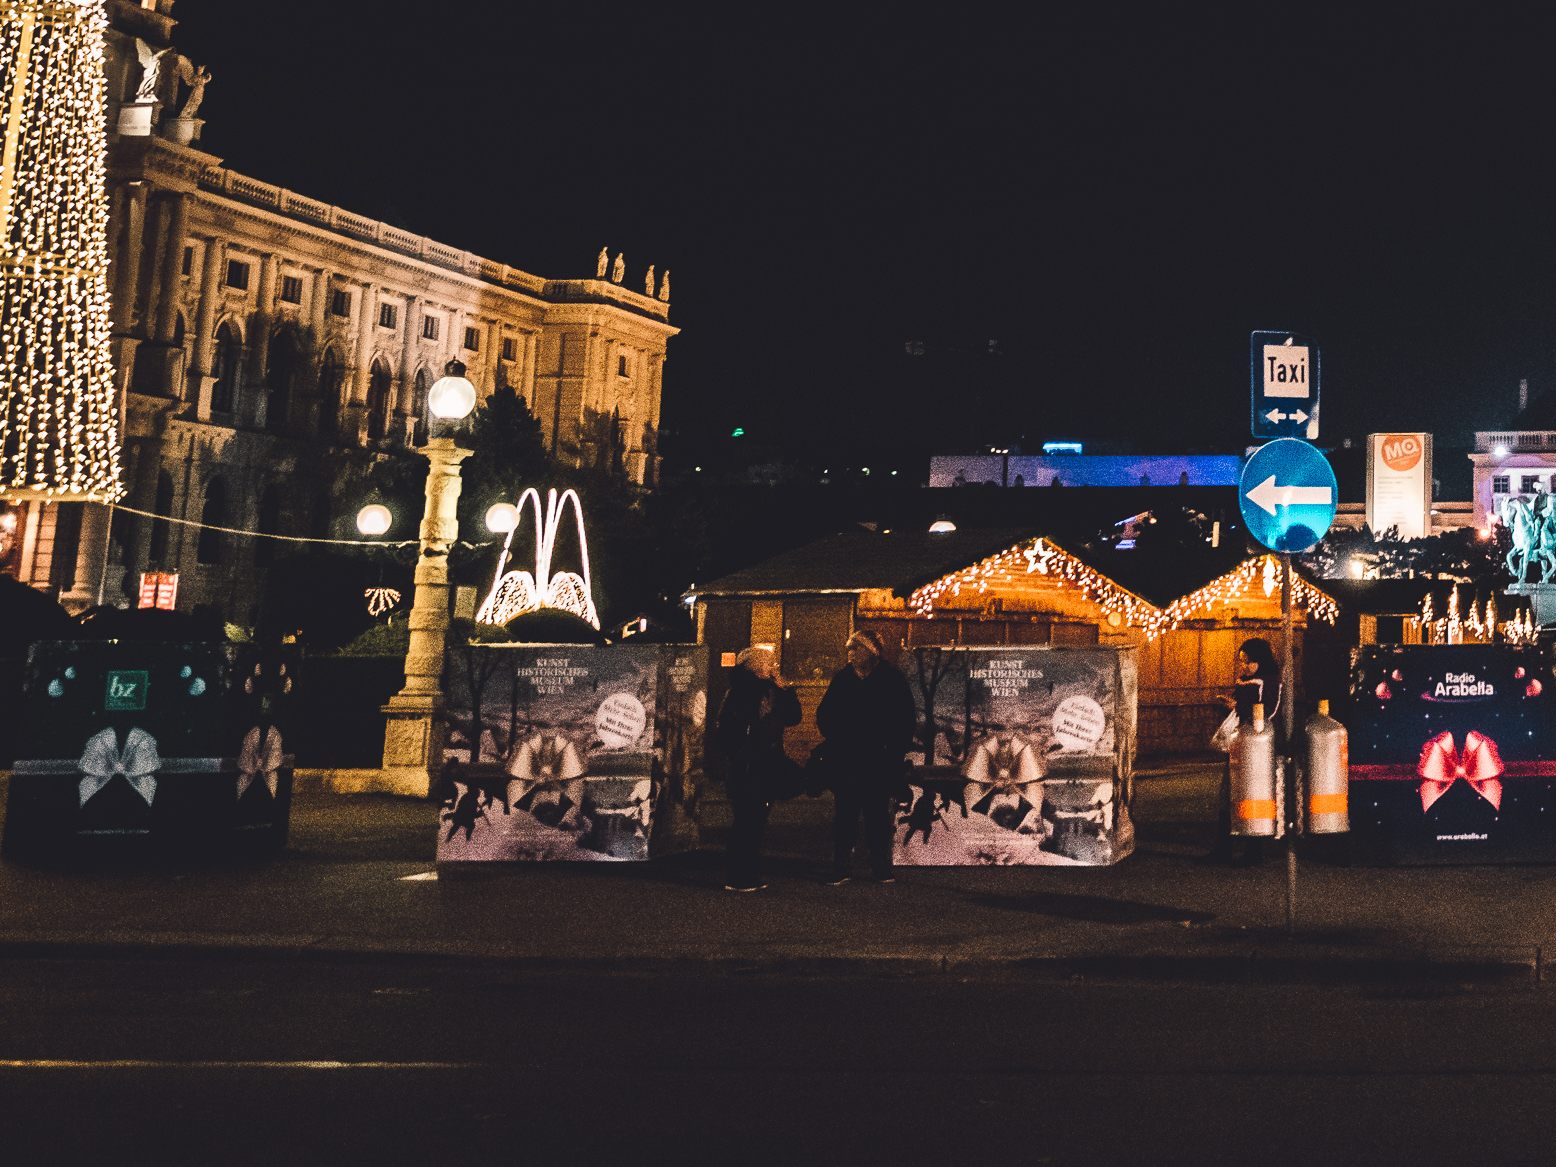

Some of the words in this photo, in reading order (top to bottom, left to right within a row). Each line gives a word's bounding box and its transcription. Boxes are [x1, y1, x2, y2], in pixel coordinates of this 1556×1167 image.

[1268, 356, 1305, 383] Taxi
[1384, 437, 1420, 460] MQ
[110, 676, 137, 698] bz
[1445, 672, 1476, 683] Radio
[1434, 682, 1494, 697] Arabella
